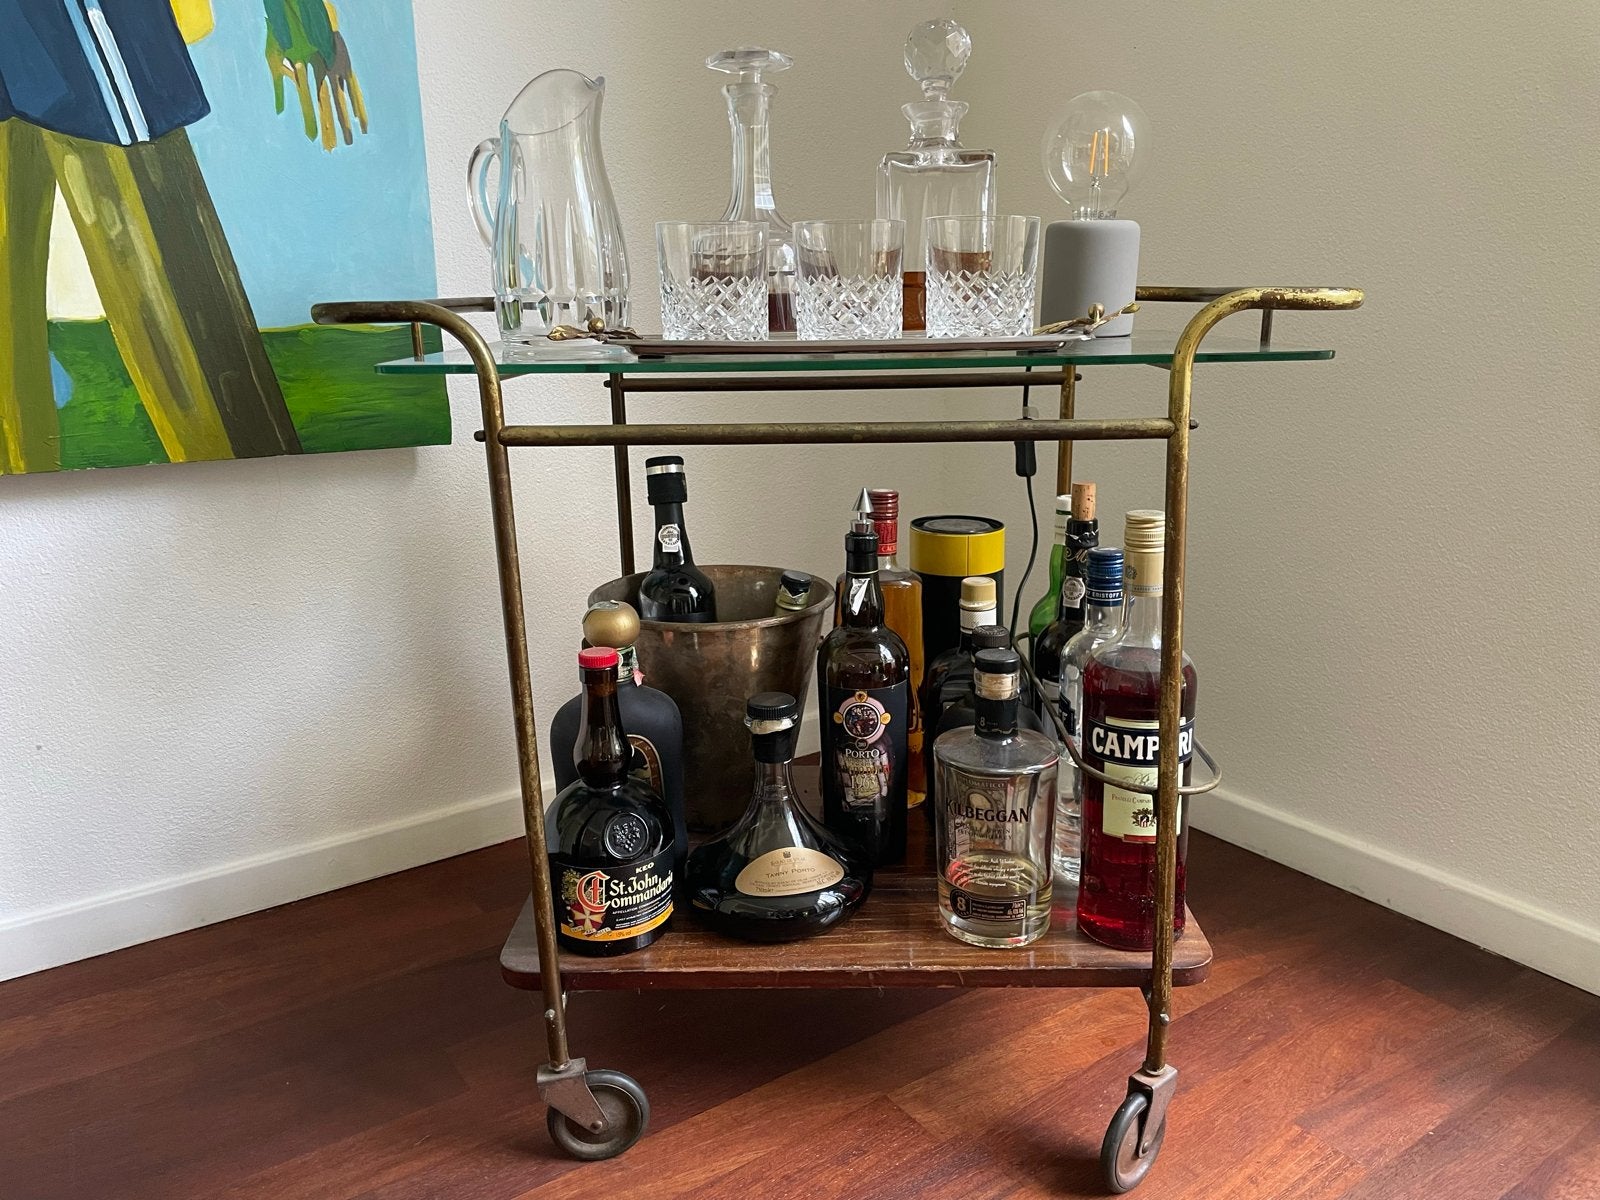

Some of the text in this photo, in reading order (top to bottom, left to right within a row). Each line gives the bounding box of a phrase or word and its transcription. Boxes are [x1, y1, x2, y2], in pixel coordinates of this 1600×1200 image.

[1091, 591, 1120, 599] ERISTOFF
[1092, 726, 1193, 761] CAMPRI
[845, 748, 880, 759] PORTO
[946, 797, 1031, 824] KILBEGGAN
[635, 862, 655, 874] KEO
[766, 867, 816, 879] TAWNY PORTO
[609, 873, 658, 897] St. John
[956, 896, 967, 912] 8
